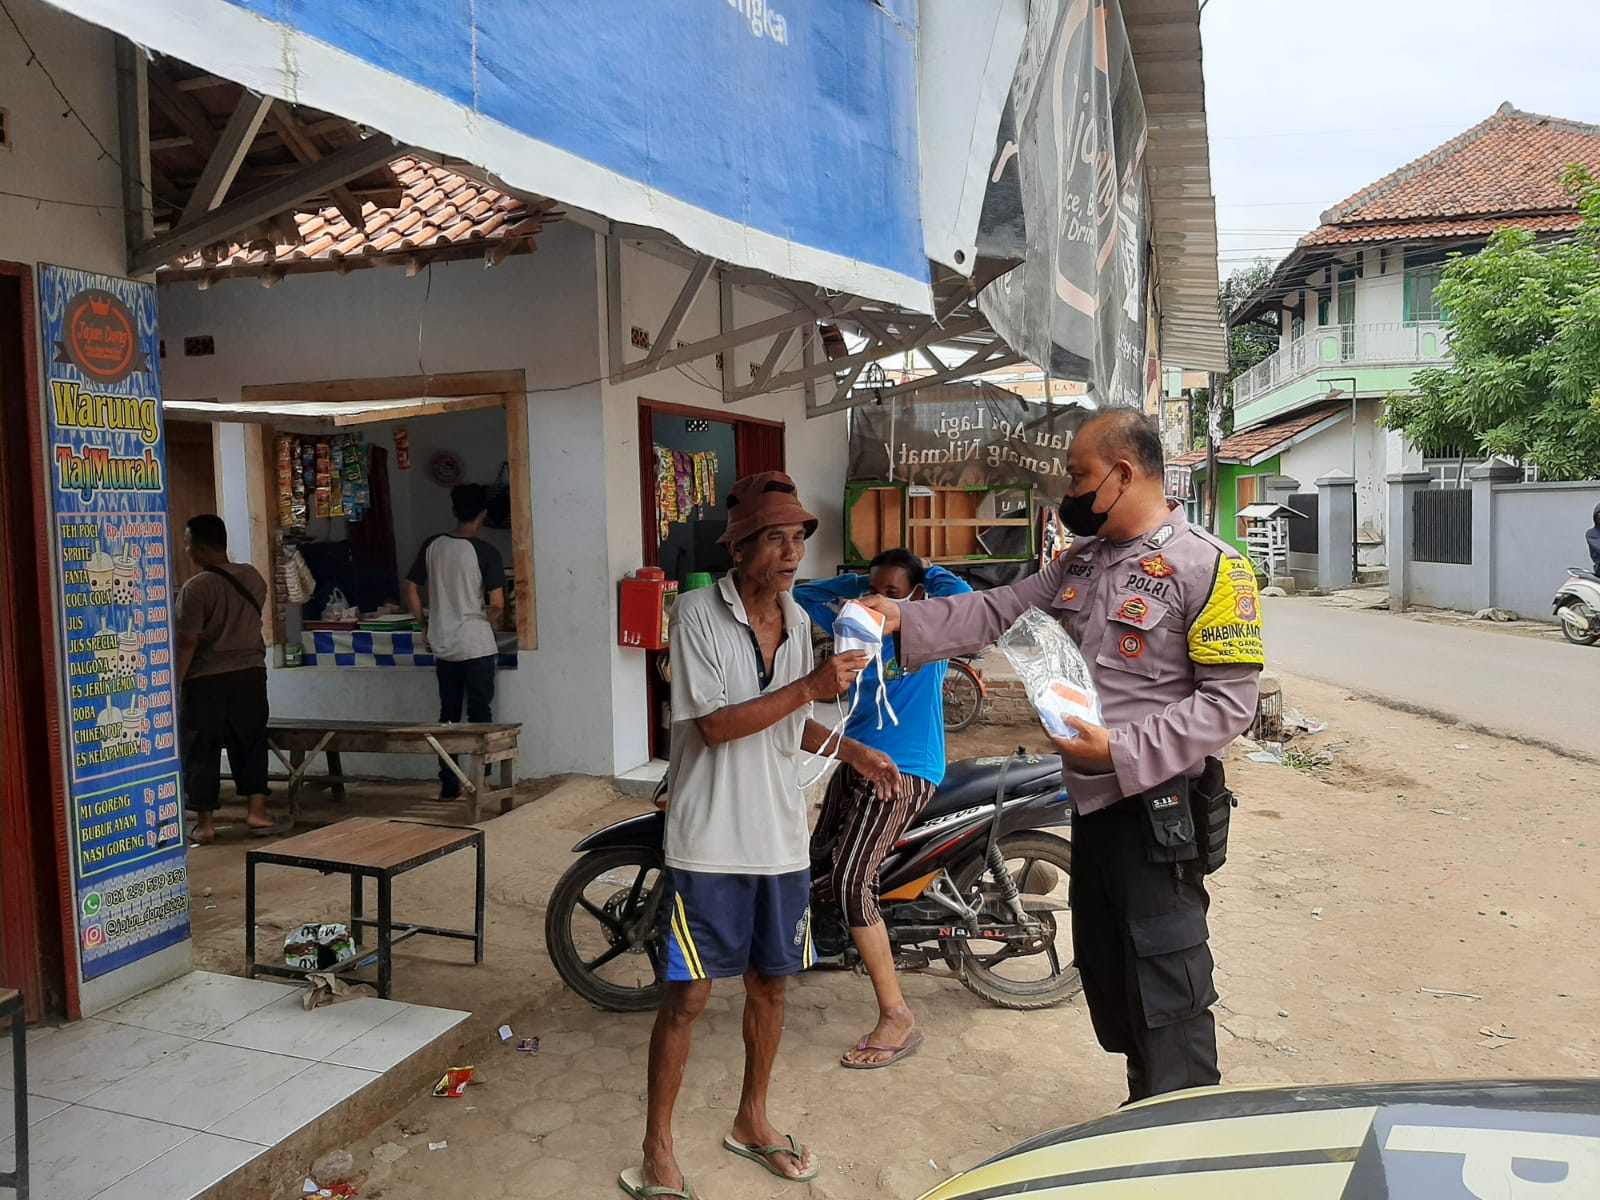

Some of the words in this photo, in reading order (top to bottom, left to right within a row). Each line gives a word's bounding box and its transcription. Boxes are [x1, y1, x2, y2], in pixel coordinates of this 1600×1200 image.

[727, 0, 788, 46] ngka
[1038, 383, 1077, 392] JLAN
[52, 380, 158, 443] Warung
[62, 524, 77, 538] TEH
[79, 524, 99, 538] POCI
[63, 546, 91, 561] SPRITE
[65, 570, 89, 585] FANTA
[1126, 574, 1170, 598] POLRI
[66, 593, 88, 608] COCA
[90, 588, 112, 605] COLA
[68, 616, 84, 630] JUS
[70, 638, 84, 653] JUS
[86, 634, 119, 651] SPECIAL
[70, 658, 110, 676] DALGONA
[72, 685, 82, 699] ES
[85, 680, 110, 696] JERUK
[112, 676, 136, 693] LEMON
[73, 706, 95, 721] BOBA
[74, 725, 105, 744] CHIKEN
[76, 753, 86, 767] ES
[89, 745, 117, 764] KELAPA
[80, 805, 92, 819] MI
[94, 794, 131, 815] GORENG
[81, 823, 113, 842] BUBUR
[114, 814, 137, 832] AYAM
[83, 847, 105, 865] NASI
[106, 834, 144, 856] GORENG
[105, 888, 125, 906] 081
[127, 881, 146, 900] 299
[147, 874, 165, 892] 599
